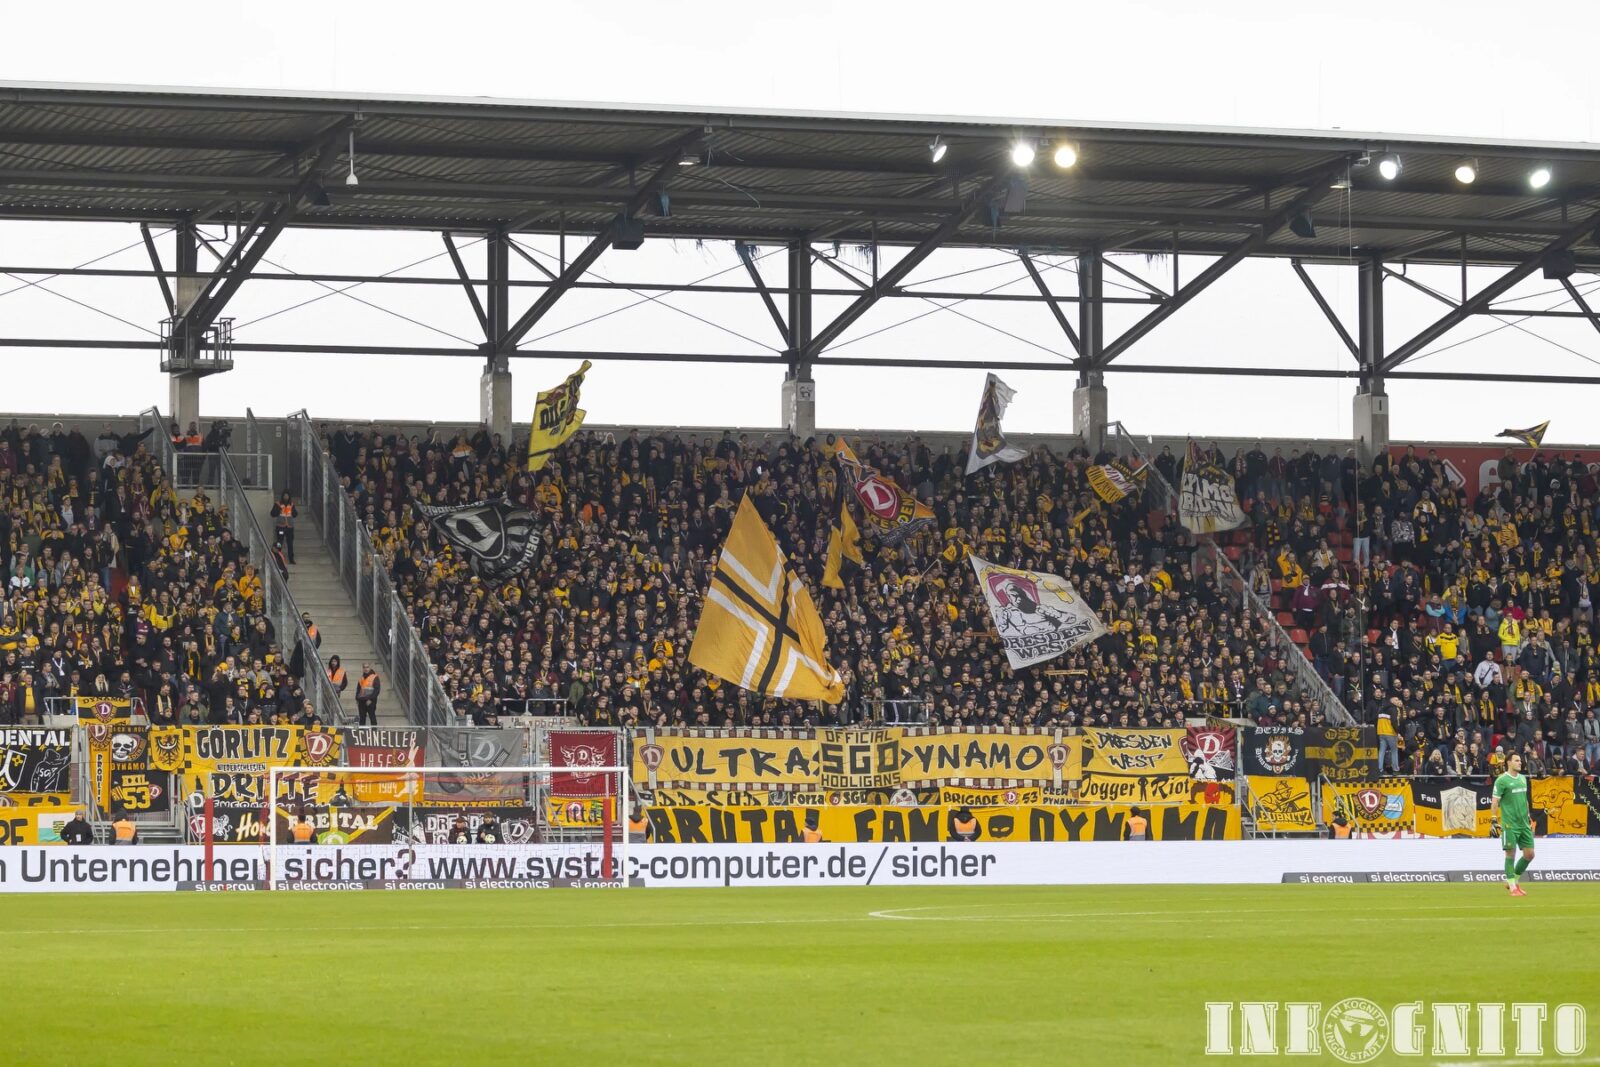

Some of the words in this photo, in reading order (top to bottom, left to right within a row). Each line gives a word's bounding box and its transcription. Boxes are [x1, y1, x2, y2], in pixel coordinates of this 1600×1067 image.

[197, 725, 290, 759] GÖRLITZ
[351, 728, 417, 748] SCHNELLER
[825, 730, 893, 743] OFFICIAL
[1096, 732, 1172, 750] DRESDEN
[821, 740, 899, 774] SGD
[1109, 753, 1164, 770] WEST
[821, 772, 900, 787] HOOLIGANS
[1080, 774, 1136, 801] Jogger
[1151, 774, 1190, 800] Riot
[122, 787, 151, 809] 53
[944, 789, 999, 806] BRIGADE
[1022, 791, 1038, 804] 53
[1420, 793, 1437, 803] Fan
[285, 848, 416, 881] sicher?
[1299, 873, 1310, 883] si
[1370, 872, 1381, 882] si
[1383, 872, 1446, 882] electronics
[1463, 872, 1473, 882] si
[1533, 871, 1543, 880] si
[195, 881, 207, 892] si
[278, 880, 290, 891] si
[293, 881, 364, 891] electronics
[384, 880, 396, 890] si
[465, 879, 476, 889] si
[480, 879, 550, 889] electronics
